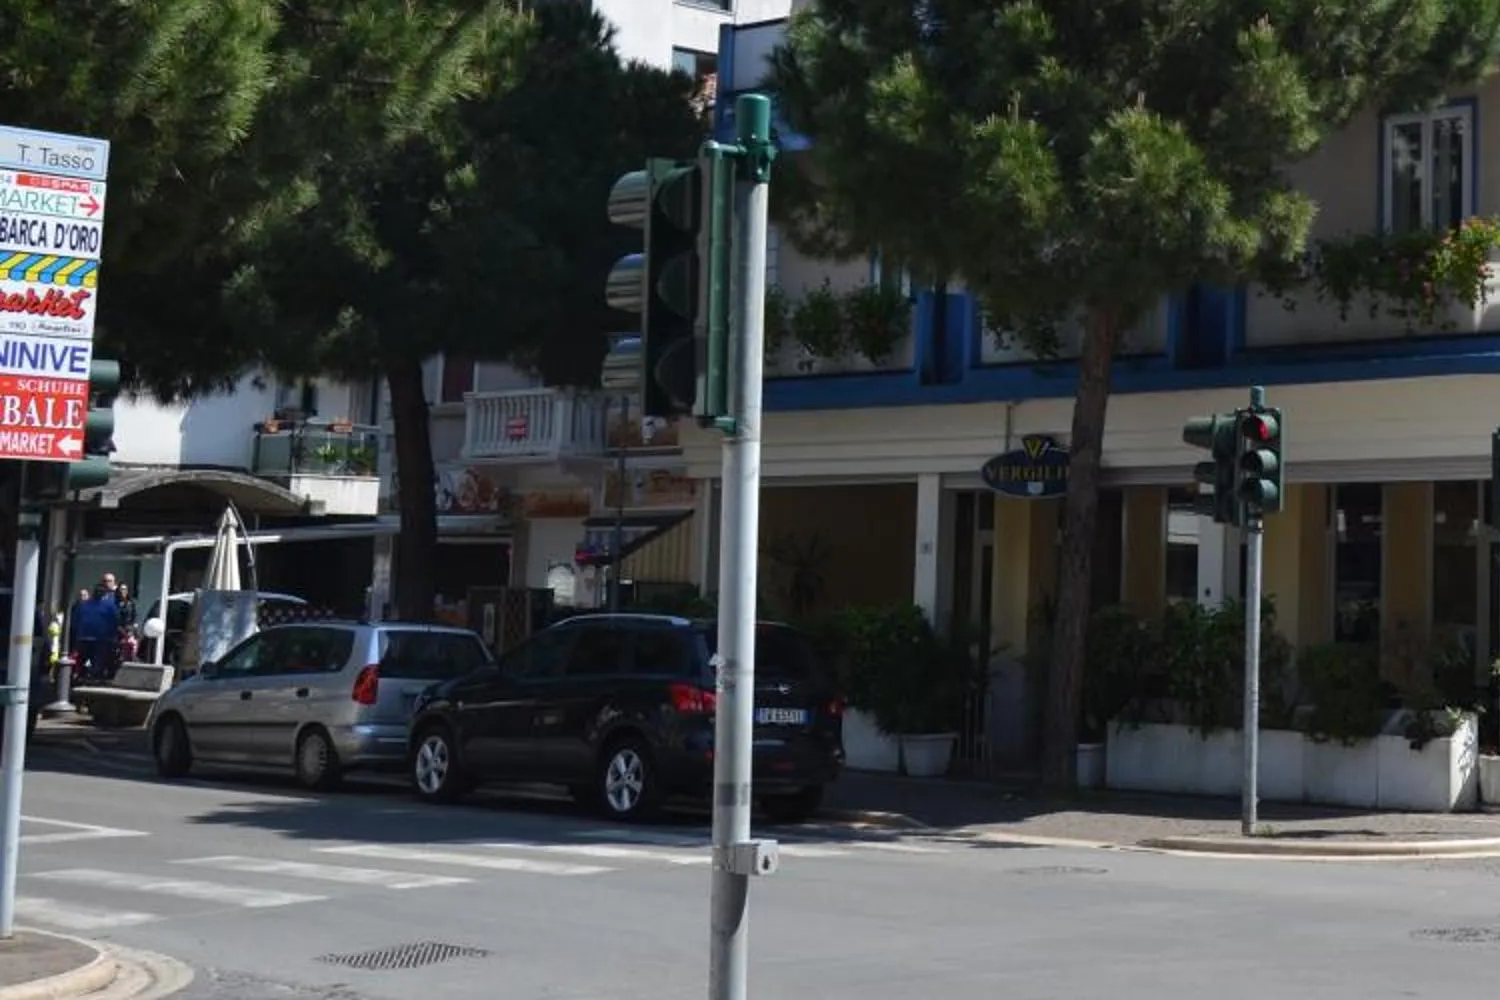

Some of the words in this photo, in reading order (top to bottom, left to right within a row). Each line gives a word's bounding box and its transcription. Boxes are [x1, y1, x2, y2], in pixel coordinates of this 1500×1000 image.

[17, 143, 32, 163] T.
[39, 147, 95, 171] Tasso
[0, 216, 47, 249] BARCA
[54, 223, 99, 253] D'ORO
[17, 378, 86, 395] SCHUHE
[0, 394, 83, 430] BALE
[0, 430, 55, 455] MARKET
